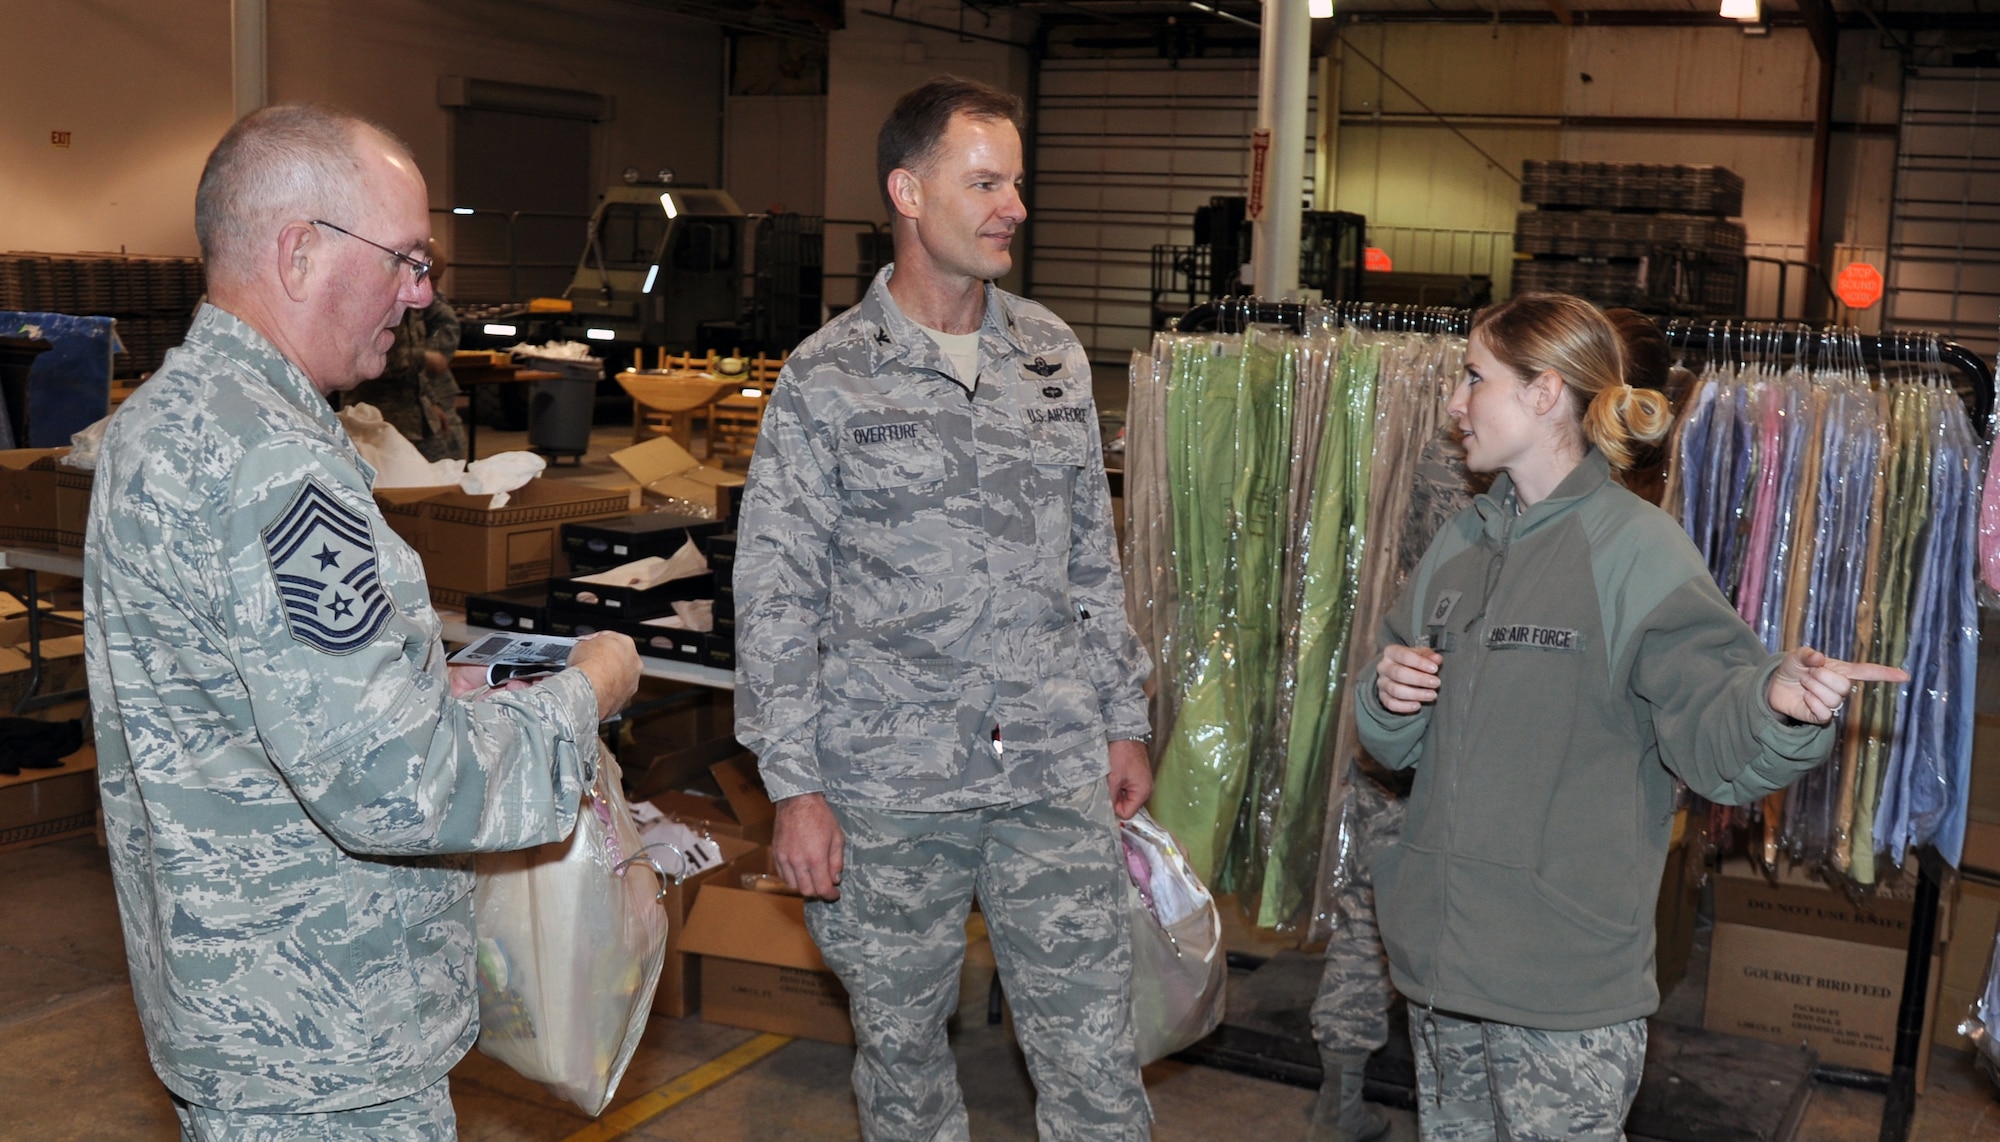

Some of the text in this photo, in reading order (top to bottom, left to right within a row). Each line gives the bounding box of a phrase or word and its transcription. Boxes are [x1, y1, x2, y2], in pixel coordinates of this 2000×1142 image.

[52, 131, 71, 144] EXIT
[1846, 267, 1872, 277] STOP
[1047, 408, 1065, 423] AIR
[853, 423, 919, 446] OVERTURF
[1508, 626, 1530, 643] AIR
[1532, 628, 1571, 647] FORCE
[1747, 899, 1772, 911] DO
[1777, 903, 1811, 916] NOT
[1816, 908, 1850, 922] USE
[1743, 965, 1893, 999] GOURMET BIRD FEED
